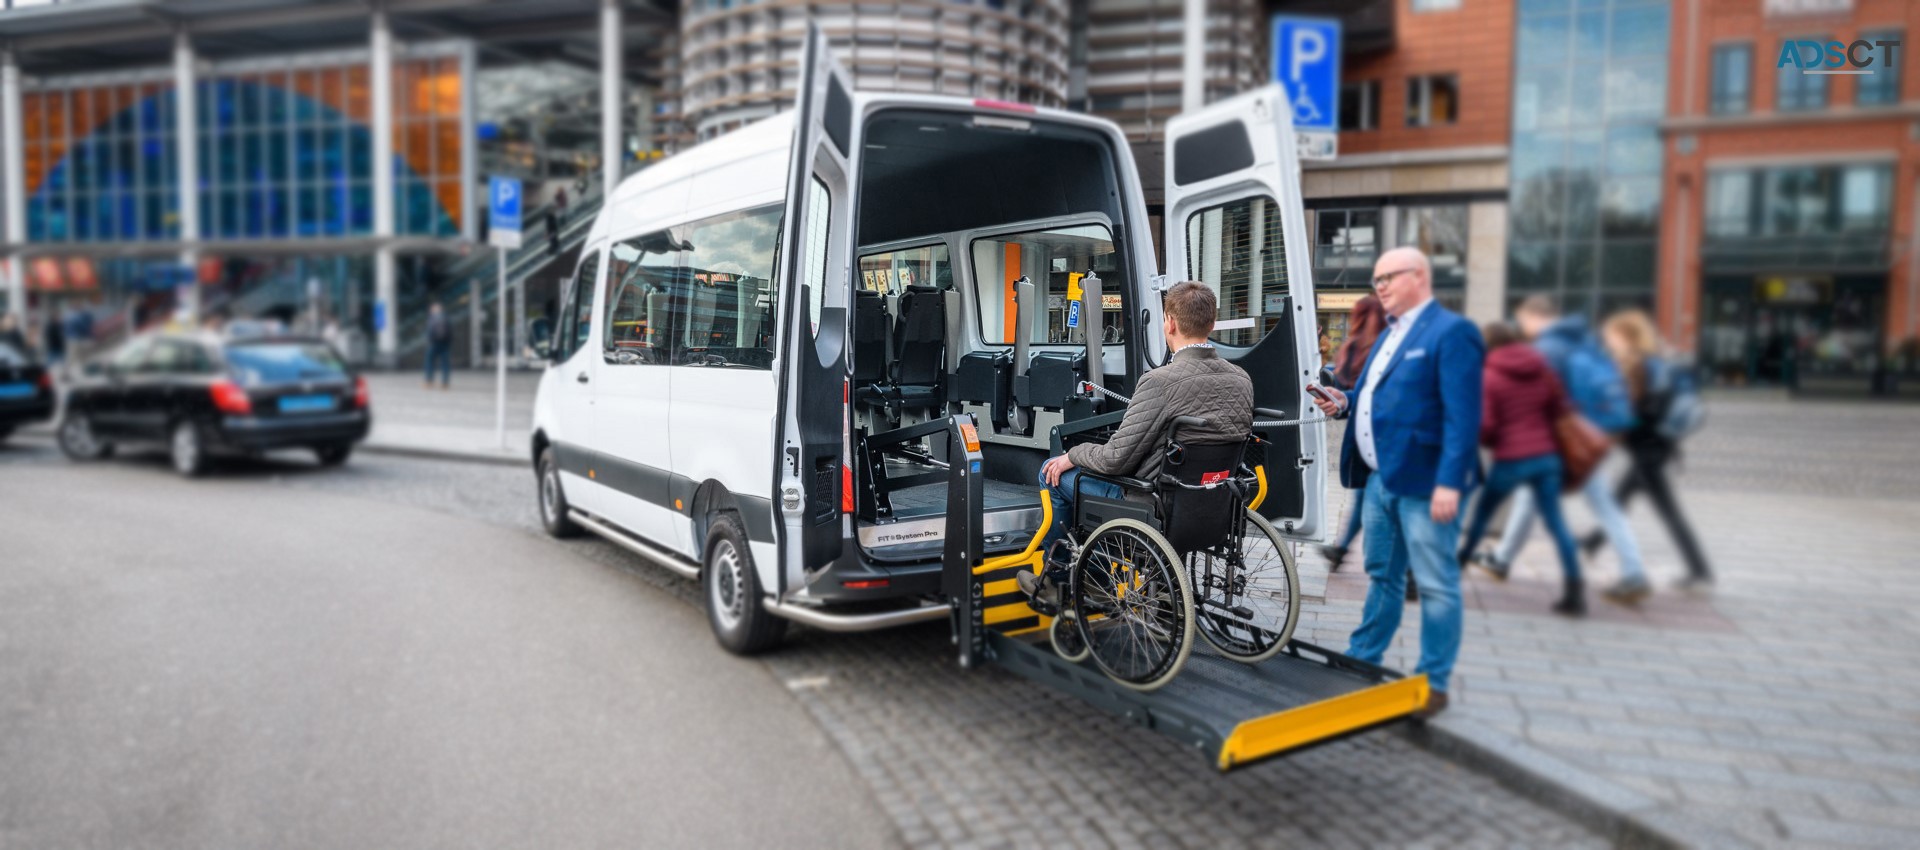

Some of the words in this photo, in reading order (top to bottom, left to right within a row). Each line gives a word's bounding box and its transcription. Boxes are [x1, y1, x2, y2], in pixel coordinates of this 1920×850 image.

[1292, 28, 1326, 80] P
[499, 182, 514, 206] P
[896, 533, 924, 541] System
